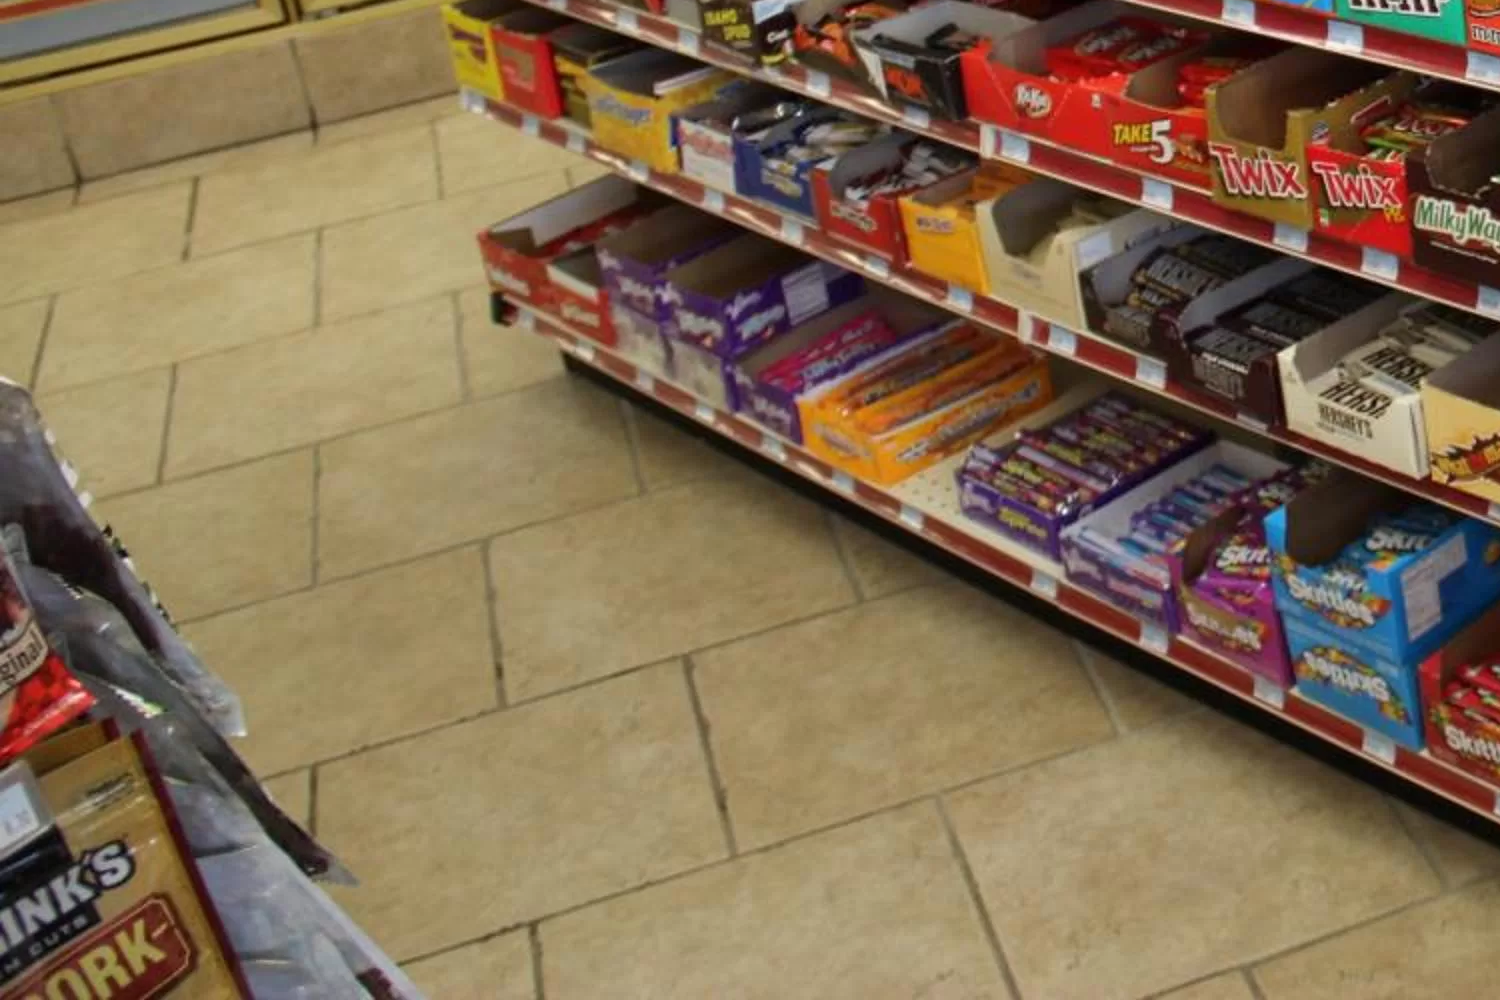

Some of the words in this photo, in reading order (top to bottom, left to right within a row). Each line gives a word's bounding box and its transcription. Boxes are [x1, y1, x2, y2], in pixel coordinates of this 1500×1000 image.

[1112, 122, 1151, 145] TAKE
[1150, 120, 1175, 164] 5
[1209, 142, 1308, 199] Twix
[1312, 159, 1403, 211] Twix
[0, 640, 44, 685] ginal
[0, 841, 135, 948] INK'S
[28, 917, 168, 1000] ORK
[29, 914, 92, 957] CUTS
